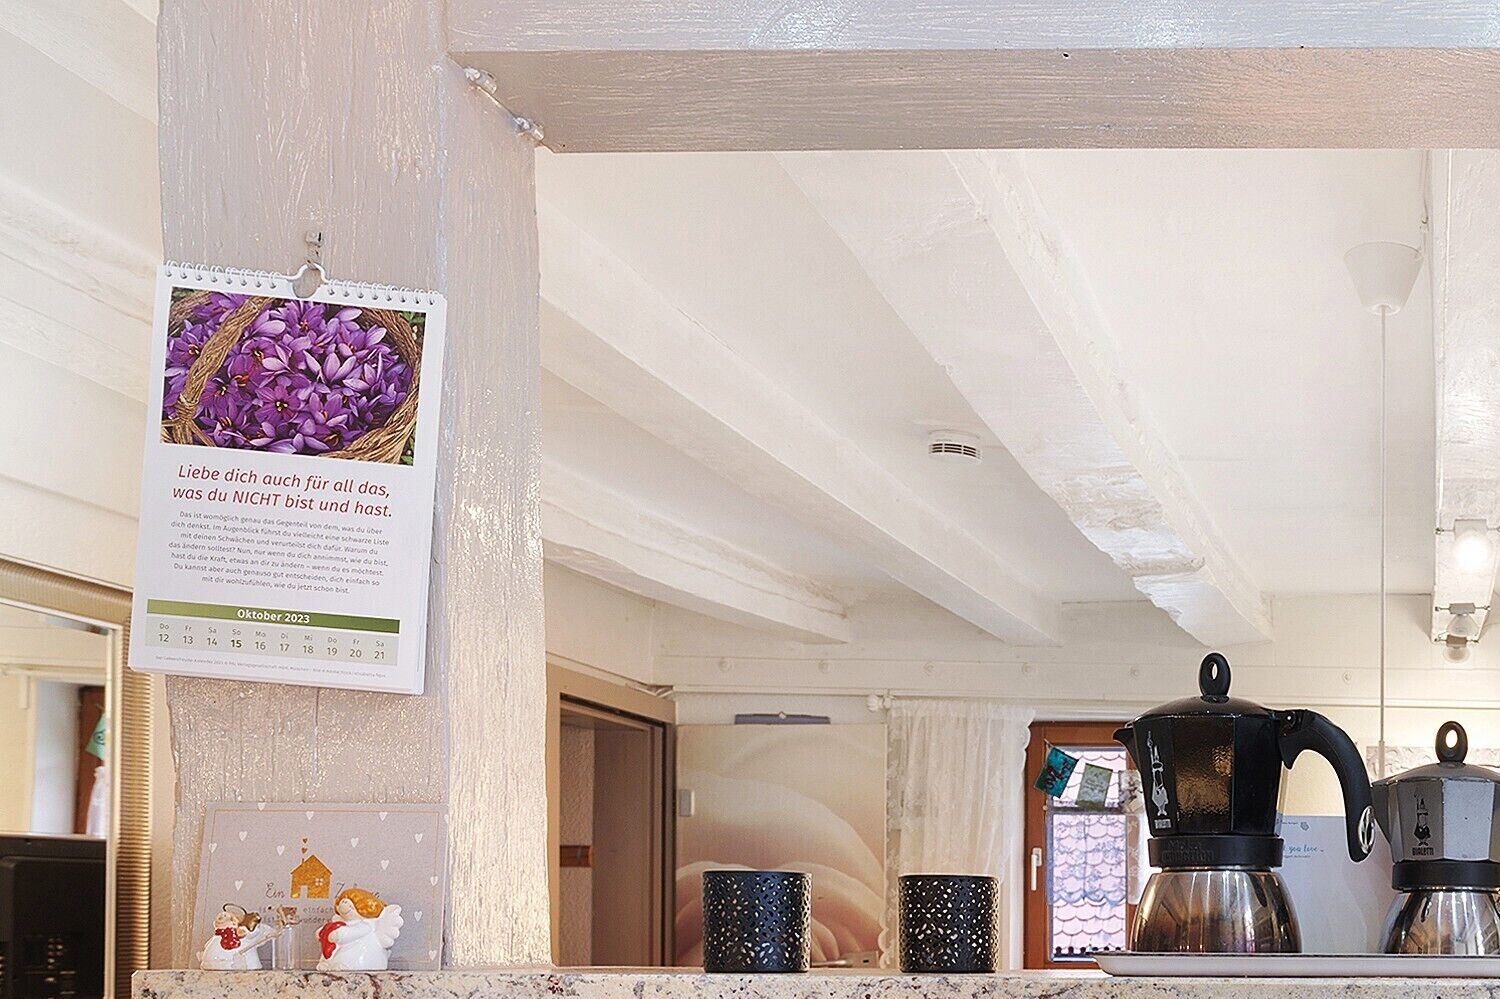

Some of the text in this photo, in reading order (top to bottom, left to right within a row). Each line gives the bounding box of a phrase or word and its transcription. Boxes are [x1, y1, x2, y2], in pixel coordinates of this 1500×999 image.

[179, 464, 390, 499] Liebe dich auch für all das,
[173, 488, 392, 517] was du NICHT bist und hast.
[237, 609, 310, 624] Oktober 2023
[159, 634, 385, 659] 12 13 14 15 16 17 18 19 20 21
[265, 883, 285, 898] Ein
